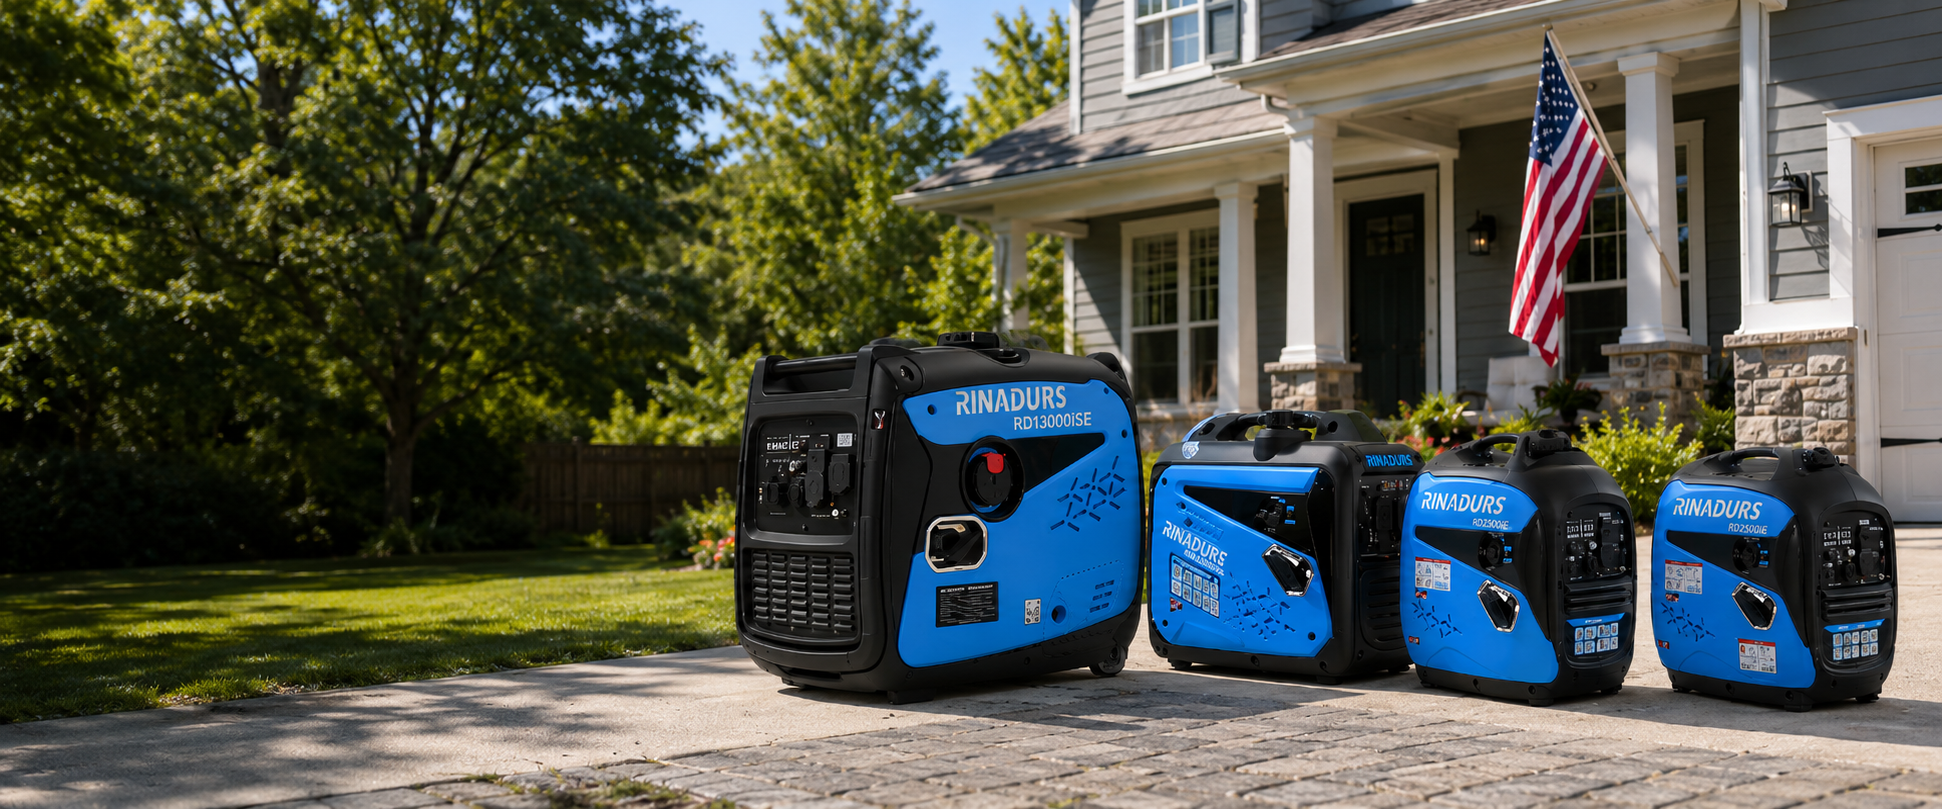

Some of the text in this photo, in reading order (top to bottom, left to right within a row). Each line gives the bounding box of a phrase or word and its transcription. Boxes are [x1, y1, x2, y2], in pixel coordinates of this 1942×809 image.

[955, 385, 1067, 415] RINADURS
[1013, 412, 1092, 430] RD13000iSE
[1364, 454, 1413, 467] RINADURS
[1421, 492, 1506, 515] RINADURS
[1673, 498, 1763, 520] RINADURS
[1162, 520, 1228, 567] RINADURS
